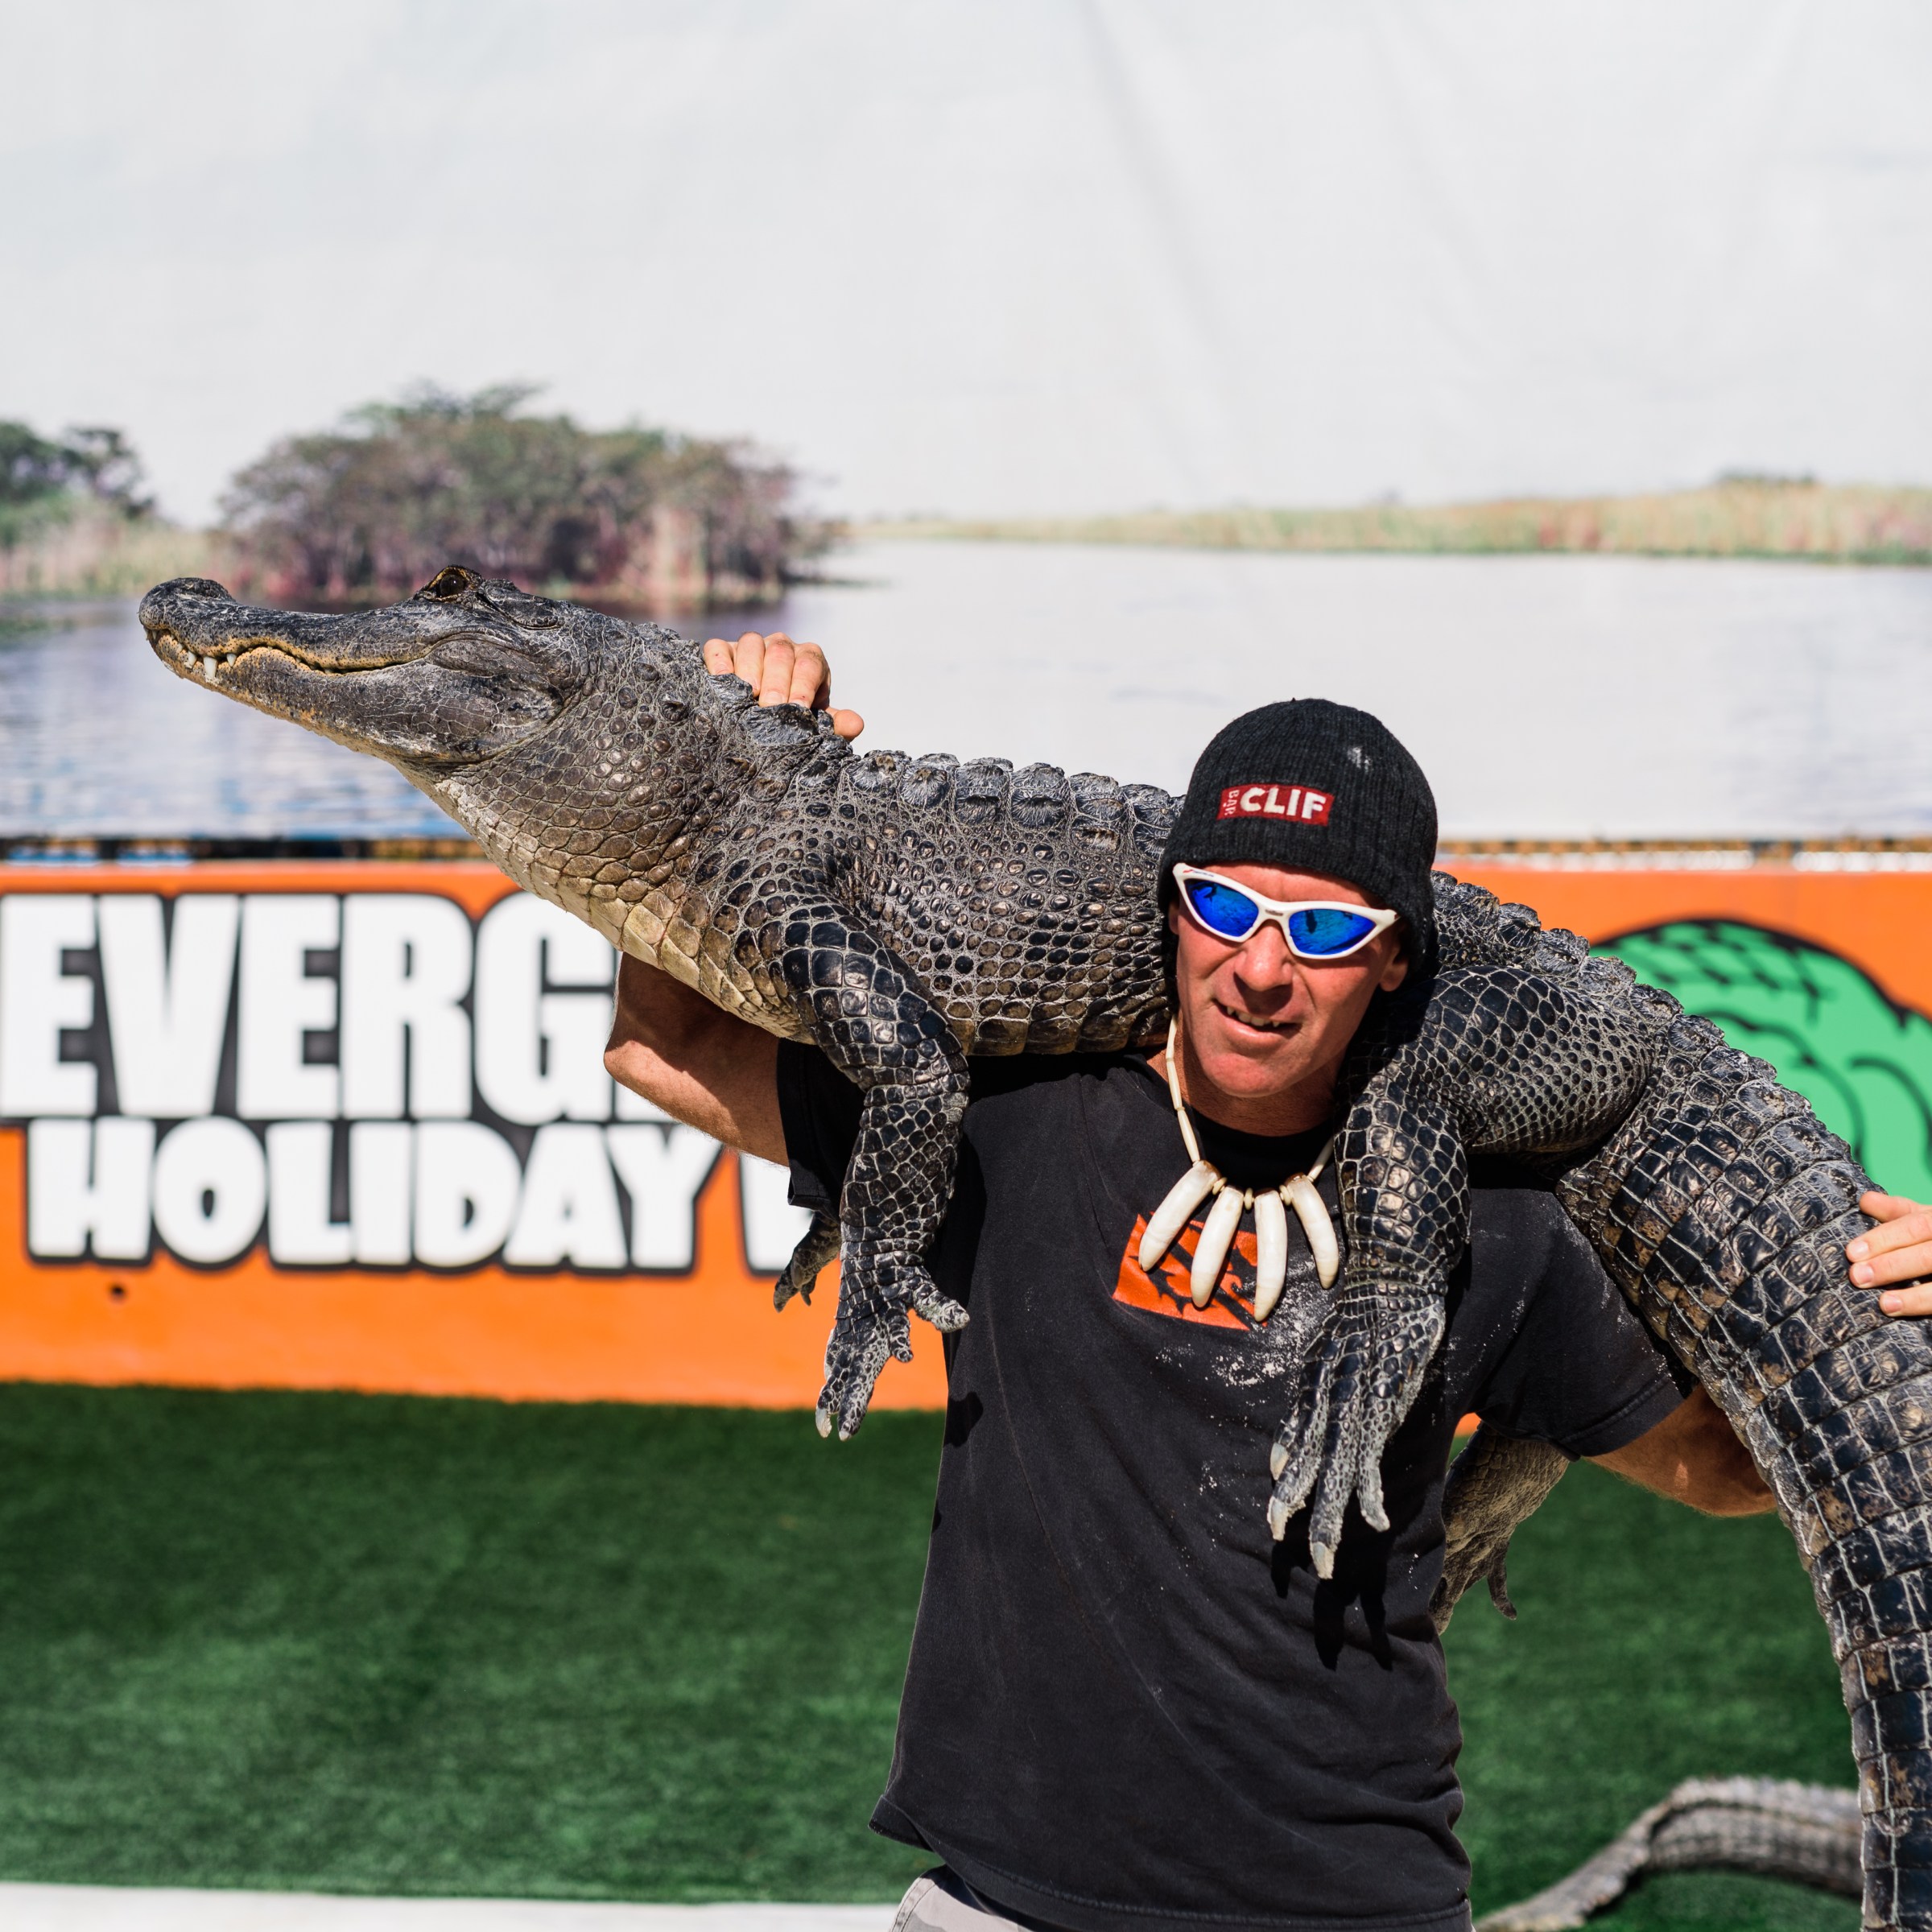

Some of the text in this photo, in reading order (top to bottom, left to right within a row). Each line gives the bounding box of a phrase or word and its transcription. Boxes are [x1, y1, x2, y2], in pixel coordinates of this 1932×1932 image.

[1241, 786, 1326, 819] CLIF
[0, 893, 681, 1124] EVERG
[27, 1118, 721, 1270] HOLIDAY
